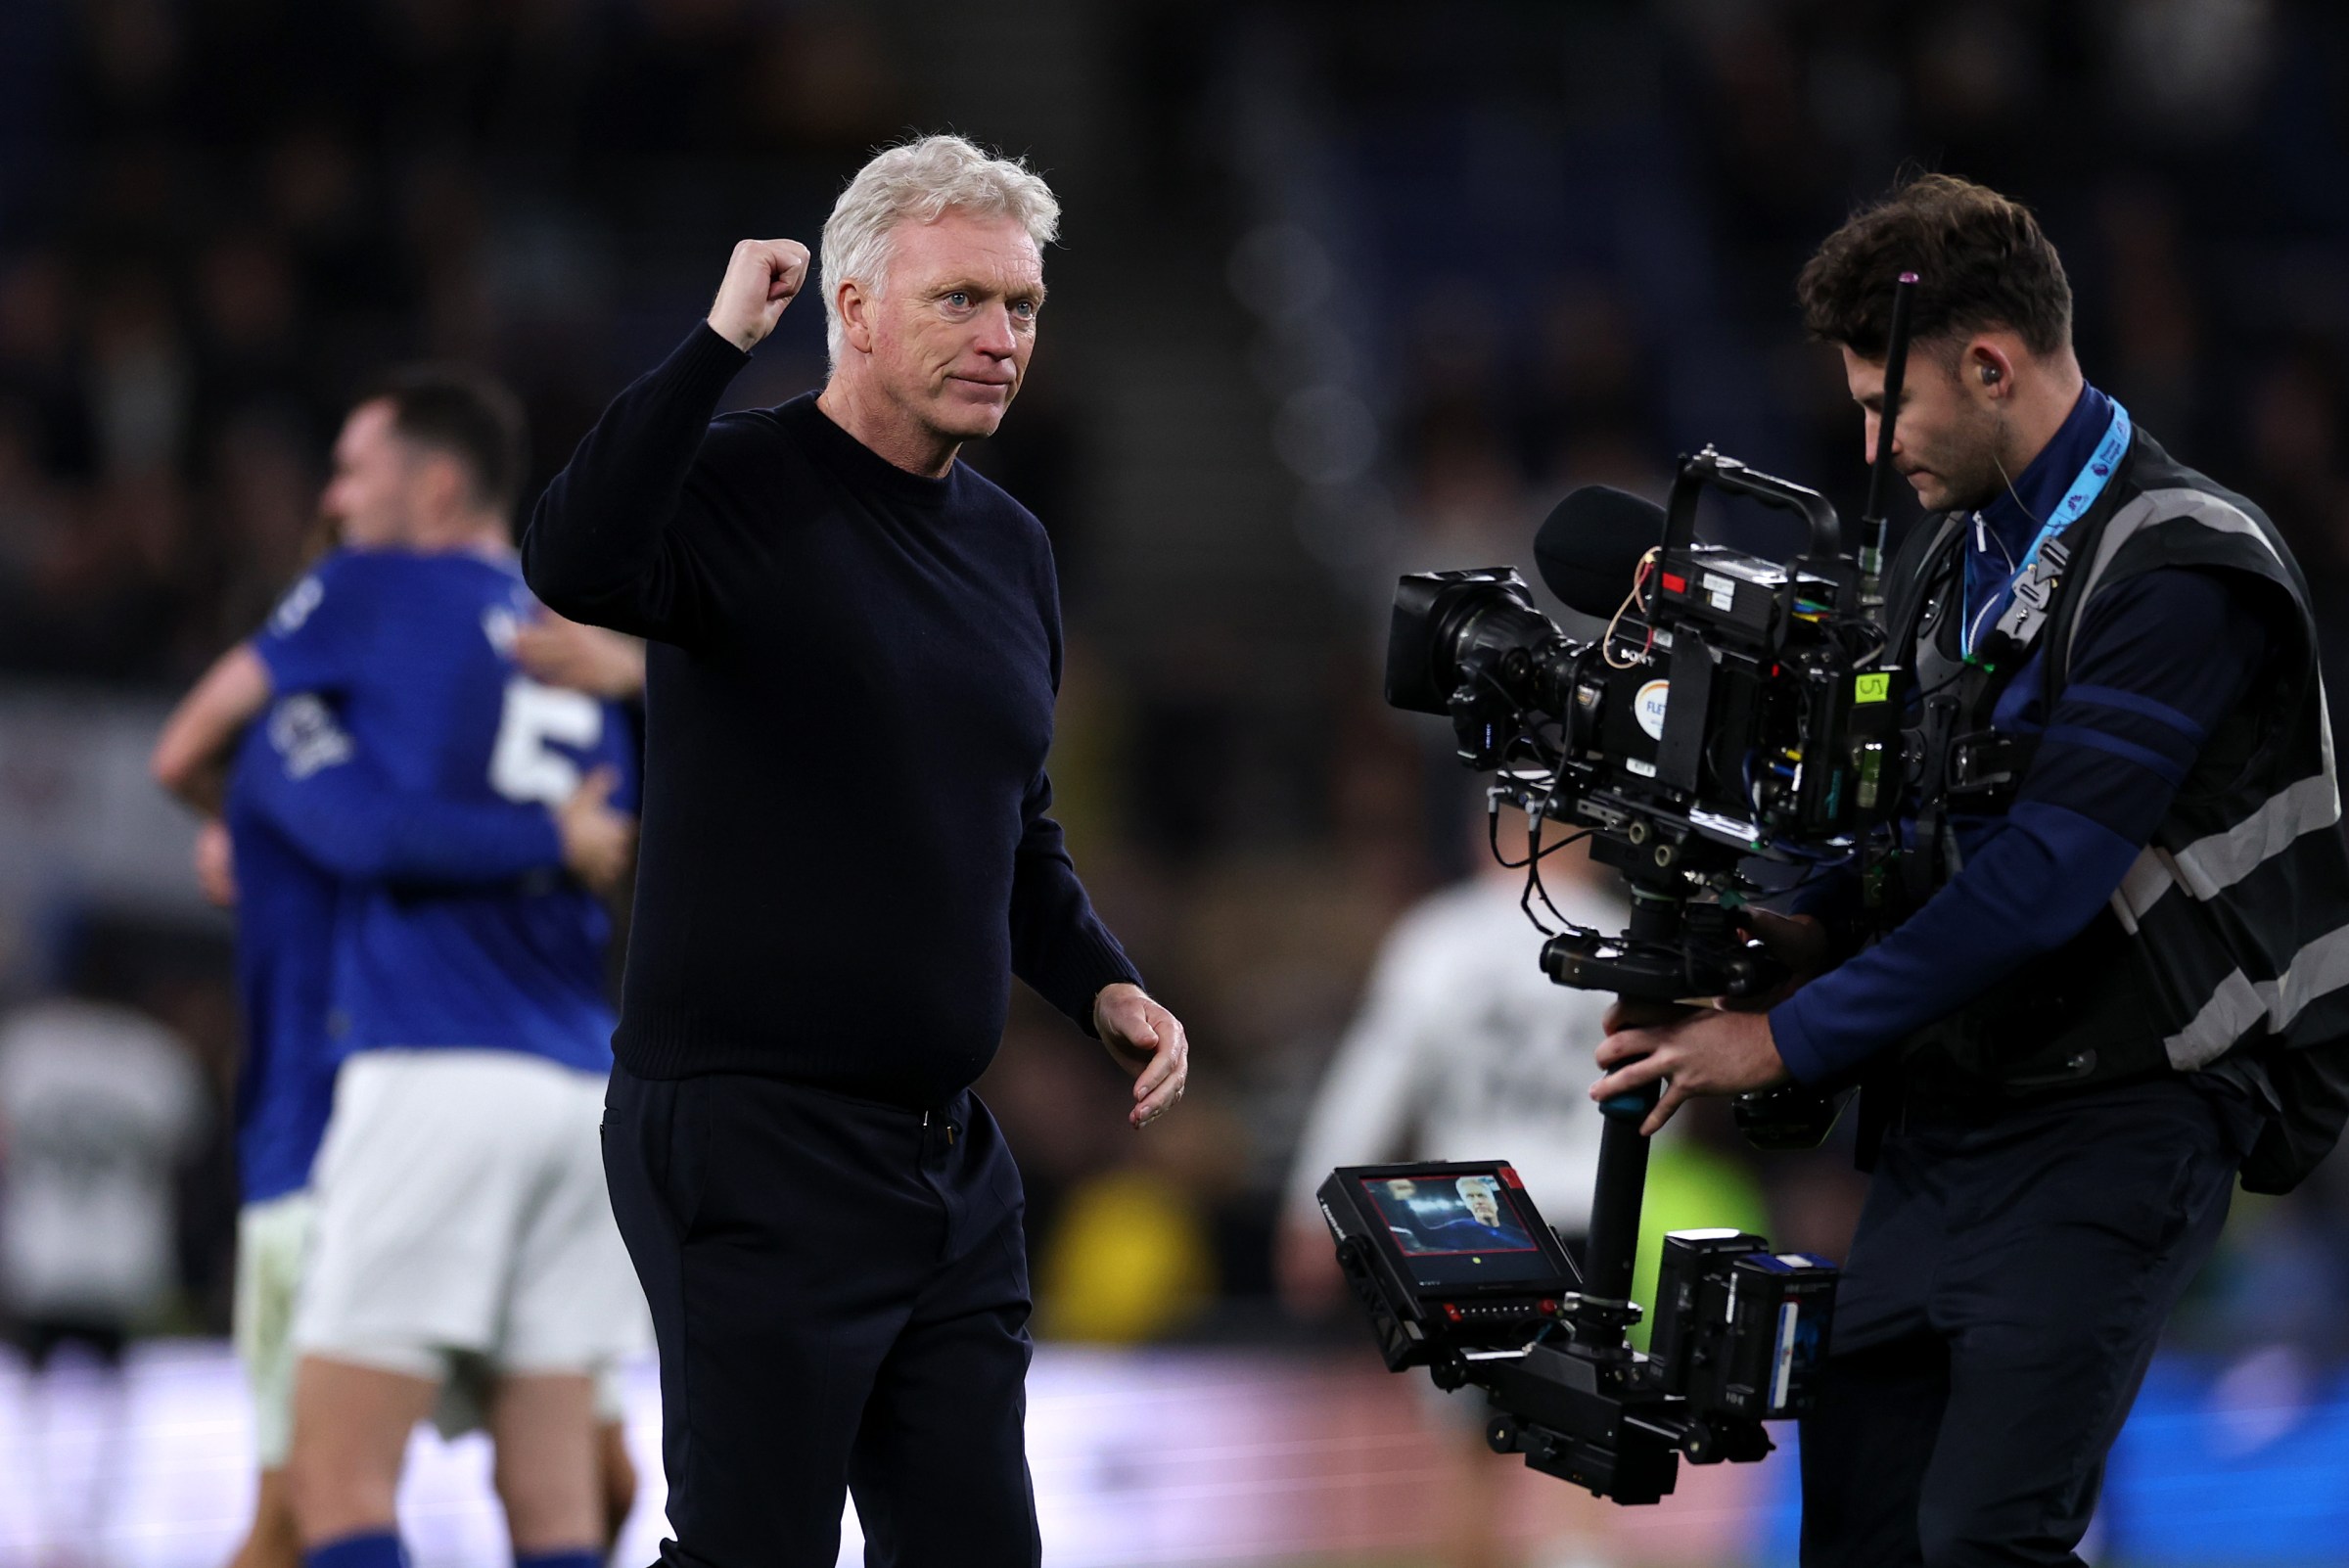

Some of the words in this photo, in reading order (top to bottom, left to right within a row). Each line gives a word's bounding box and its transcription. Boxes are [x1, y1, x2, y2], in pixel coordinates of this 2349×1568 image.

[1621, 648, 1655, 668] SONY
[1646, 700, 1666, 715] FLE
[491, 678, 602, 804] 5
